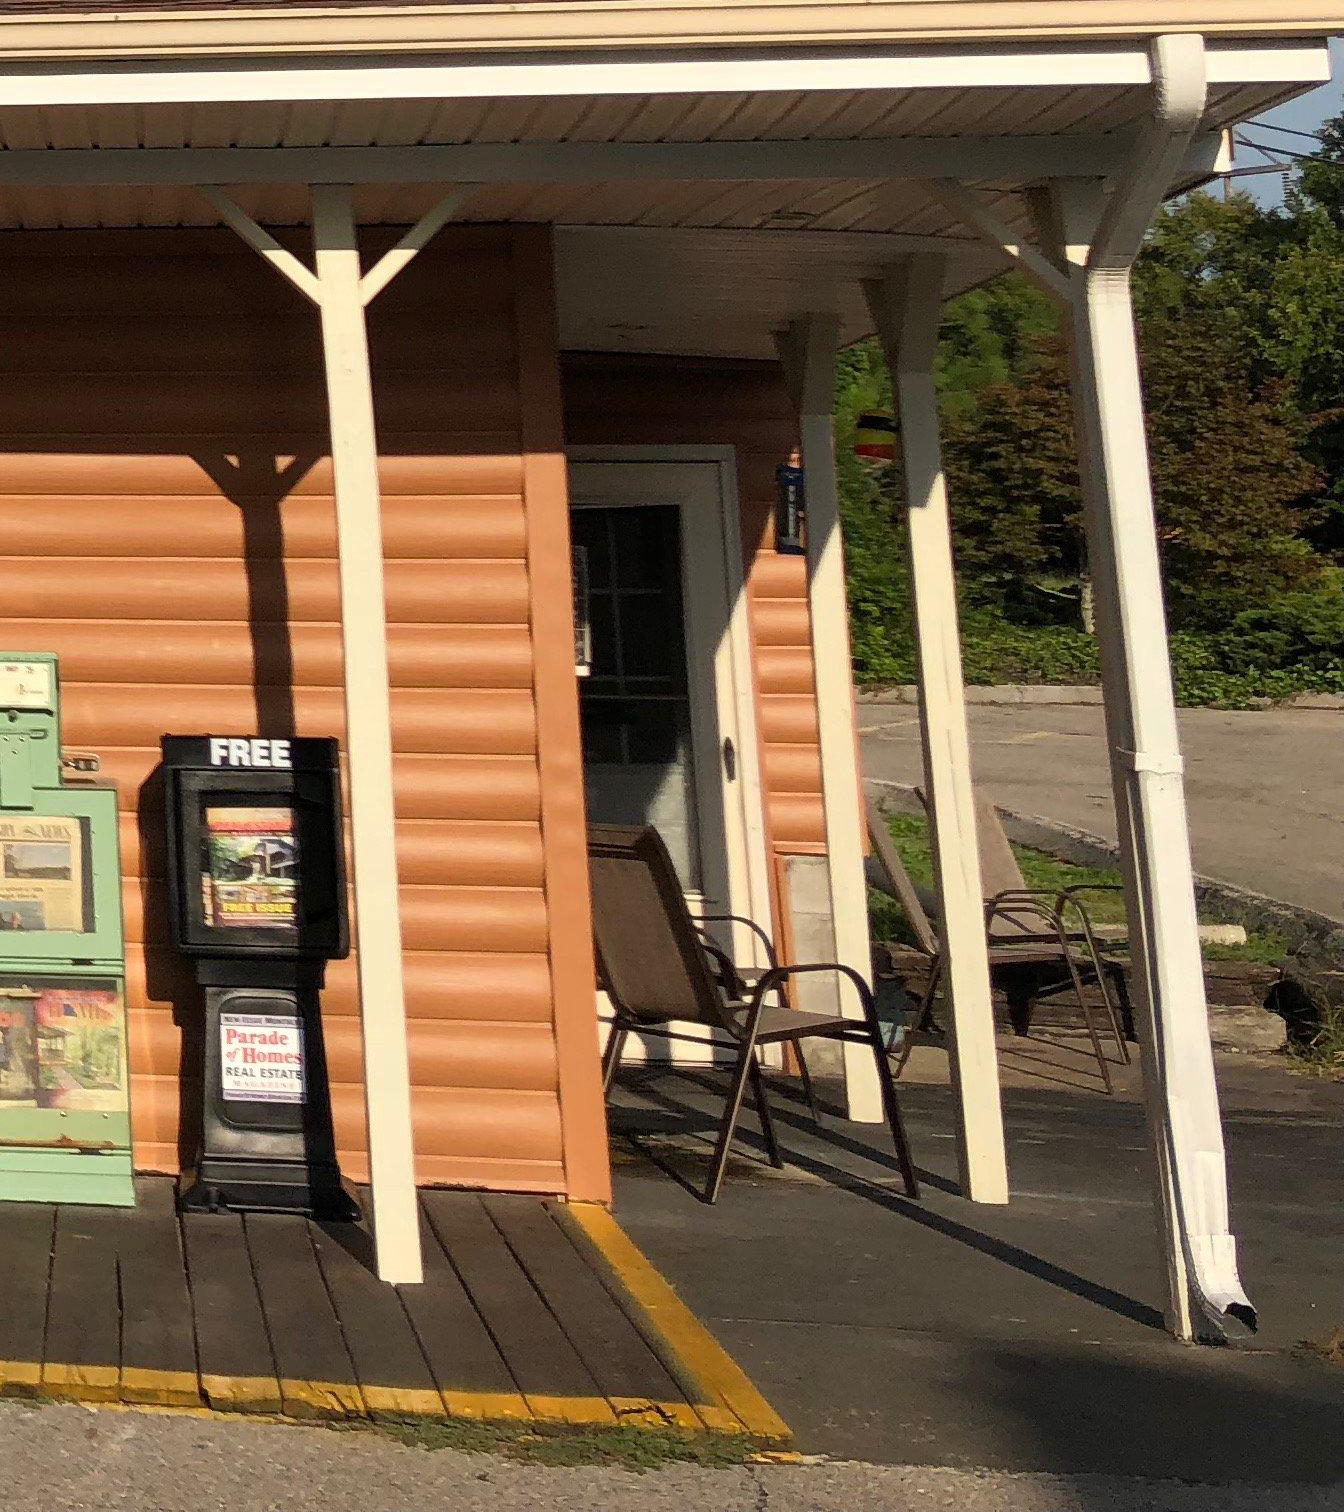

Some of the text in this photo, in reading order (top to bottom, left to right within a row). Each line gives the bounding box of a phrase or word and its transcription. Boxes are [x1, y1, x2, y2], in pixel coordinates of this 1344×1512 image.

[209, 737, 293, 768] FREE
[226, 1028, 289, 1046] Parade
[241, 1047, 303, 1065] Homes
[225, 1066, 303, 1081] REAL ESTATE
